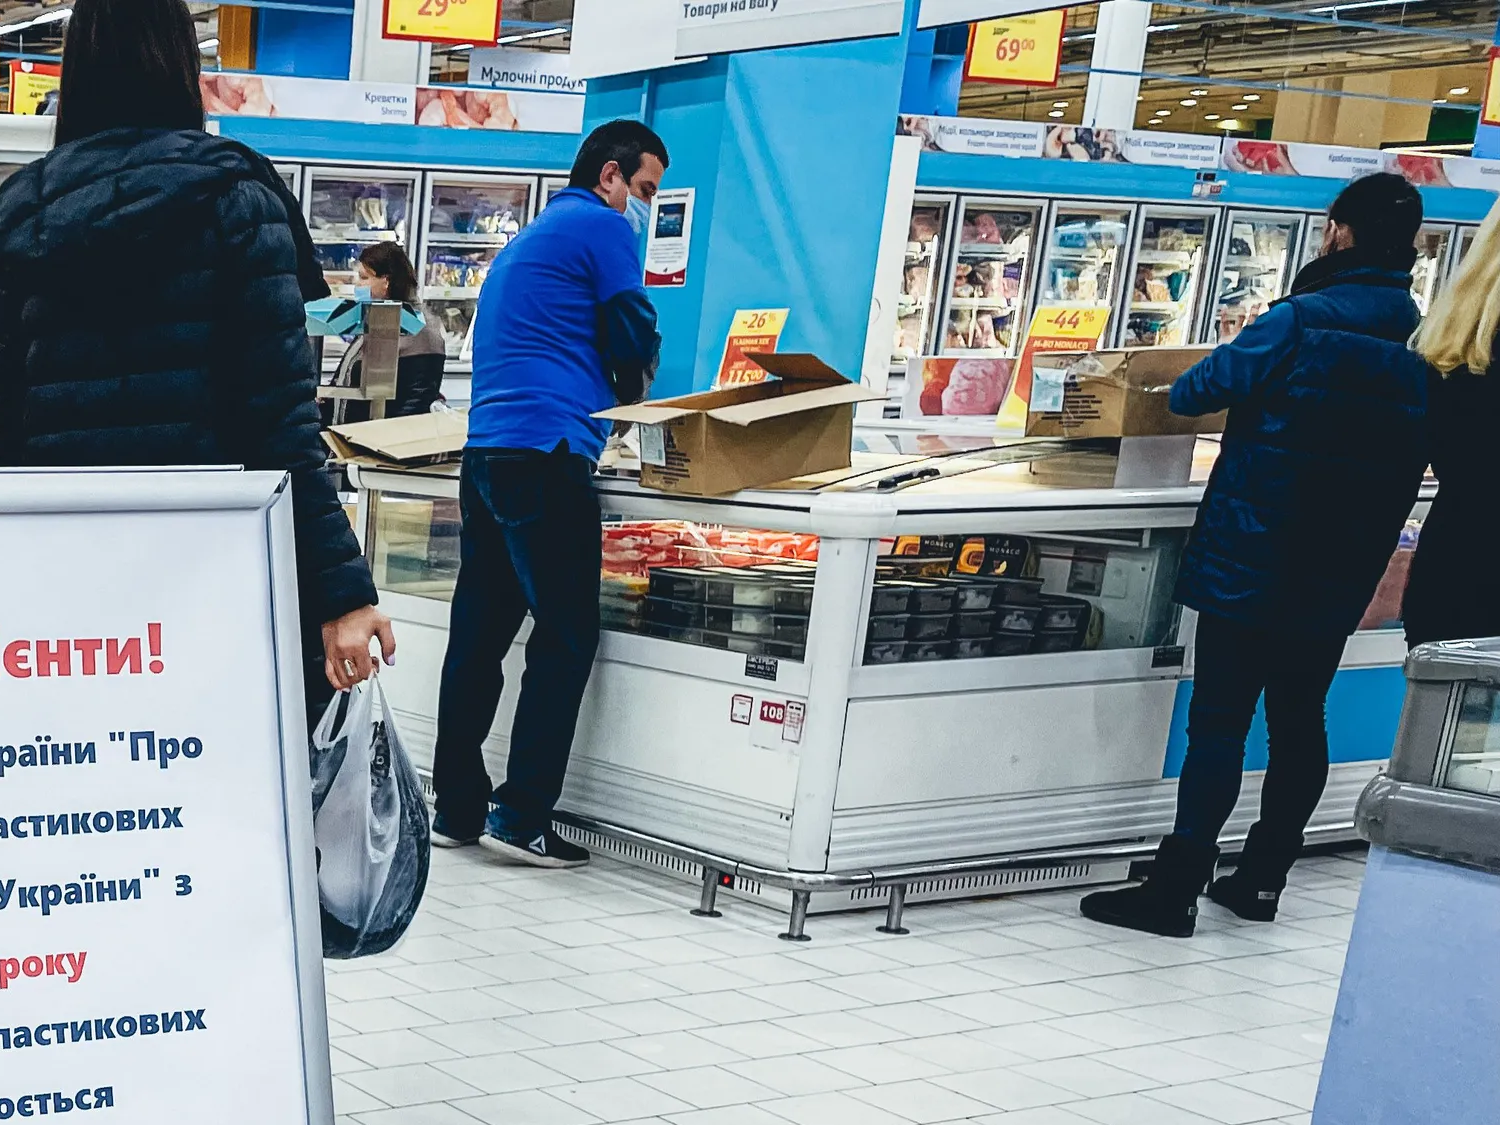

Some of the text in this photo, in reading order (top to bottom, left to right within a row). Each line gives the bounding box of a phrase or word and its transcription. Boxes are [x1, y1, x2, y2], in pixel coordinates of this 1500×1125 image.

[683, 3, 728, 19] Товари
[730, 0, 746, 12] на
[364, 92, 408, 104] Креветки
[924, 540, 955, 549] MONACO
[989, 547, 1021, 556] MONACO
[762, 705, 783, 720] 108
[109, 730, 203, 770] "Про
[175, 874, 193, 896] з
